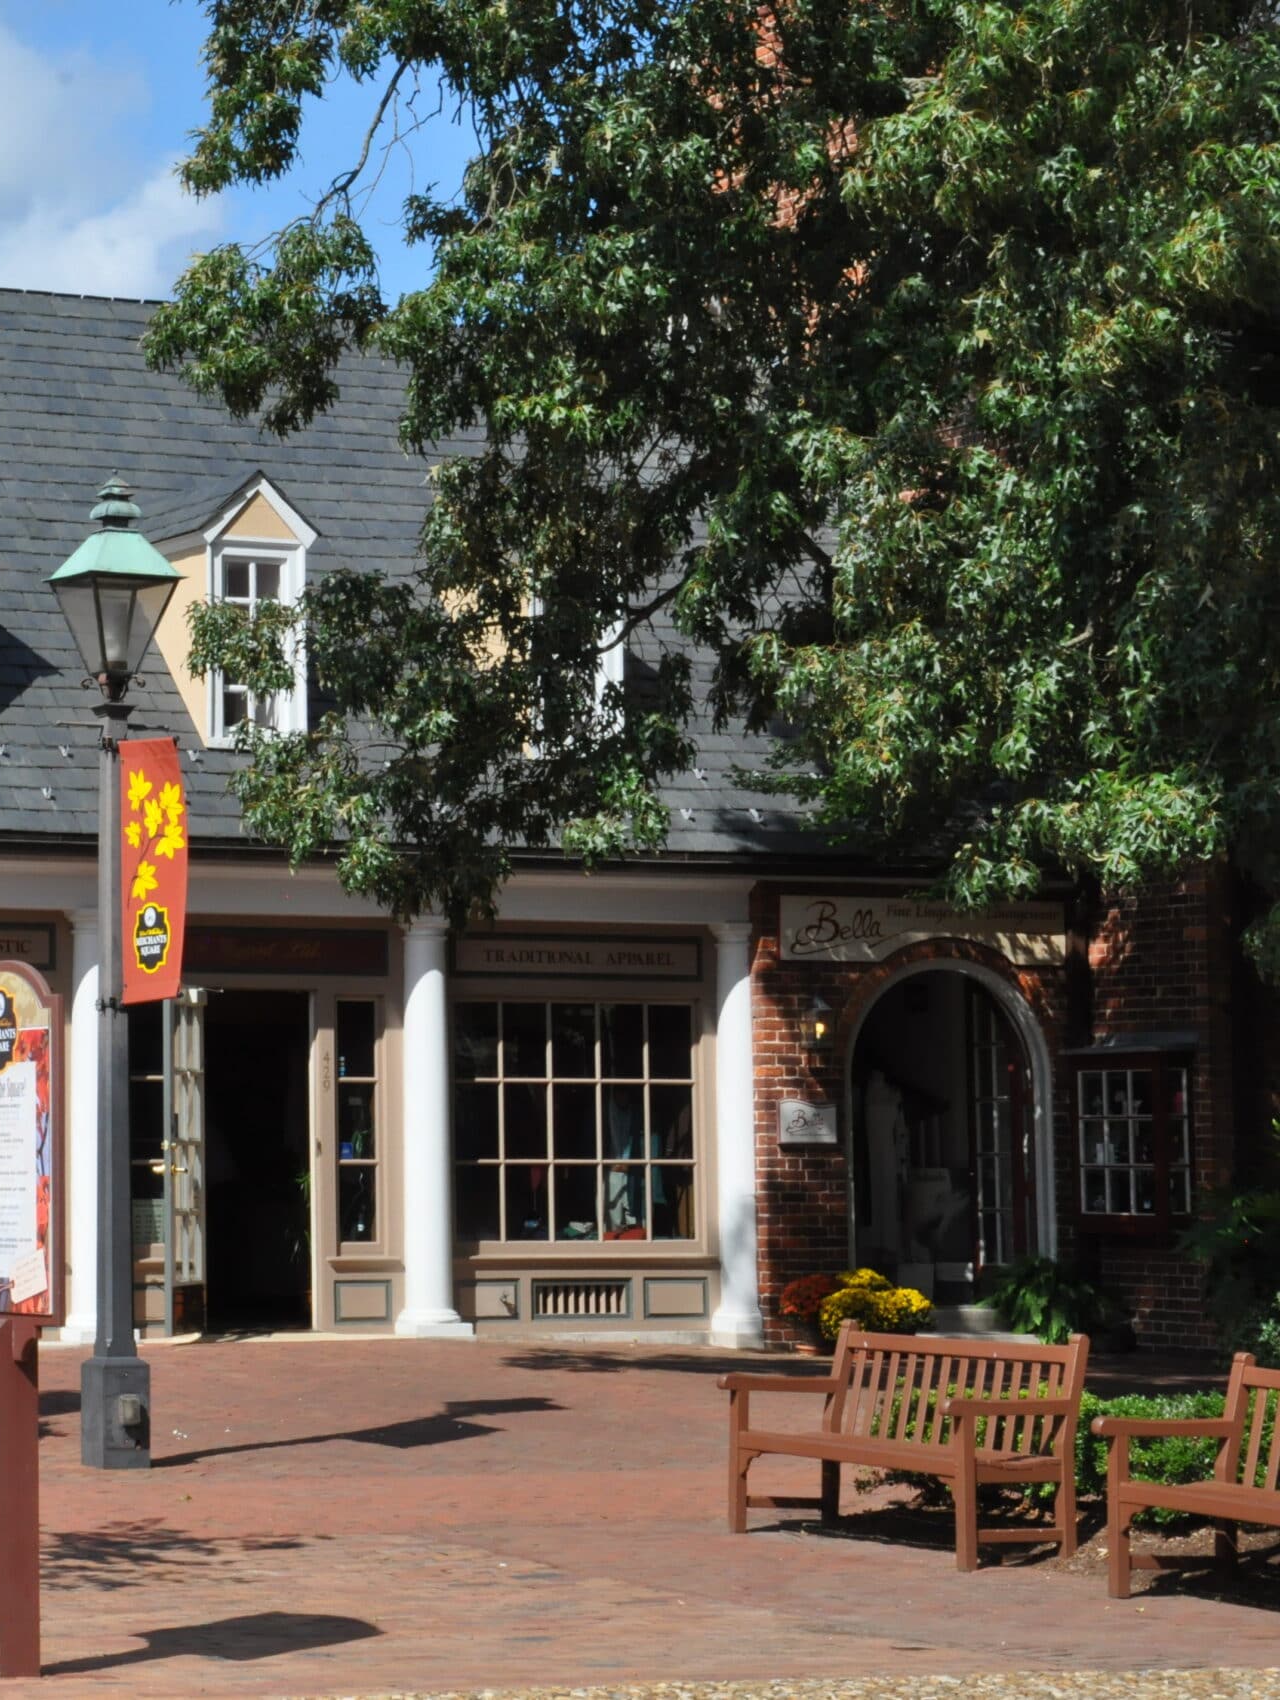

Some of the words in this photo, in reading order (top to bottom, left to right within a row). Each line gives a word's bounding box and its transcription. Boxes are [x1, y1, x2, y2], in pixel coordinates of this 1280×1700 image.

[791, 900, 883, 953] Bella
[483, 949, 593, 965] TRADITIONAL
[606, 951, 676, 966] APPAREL
